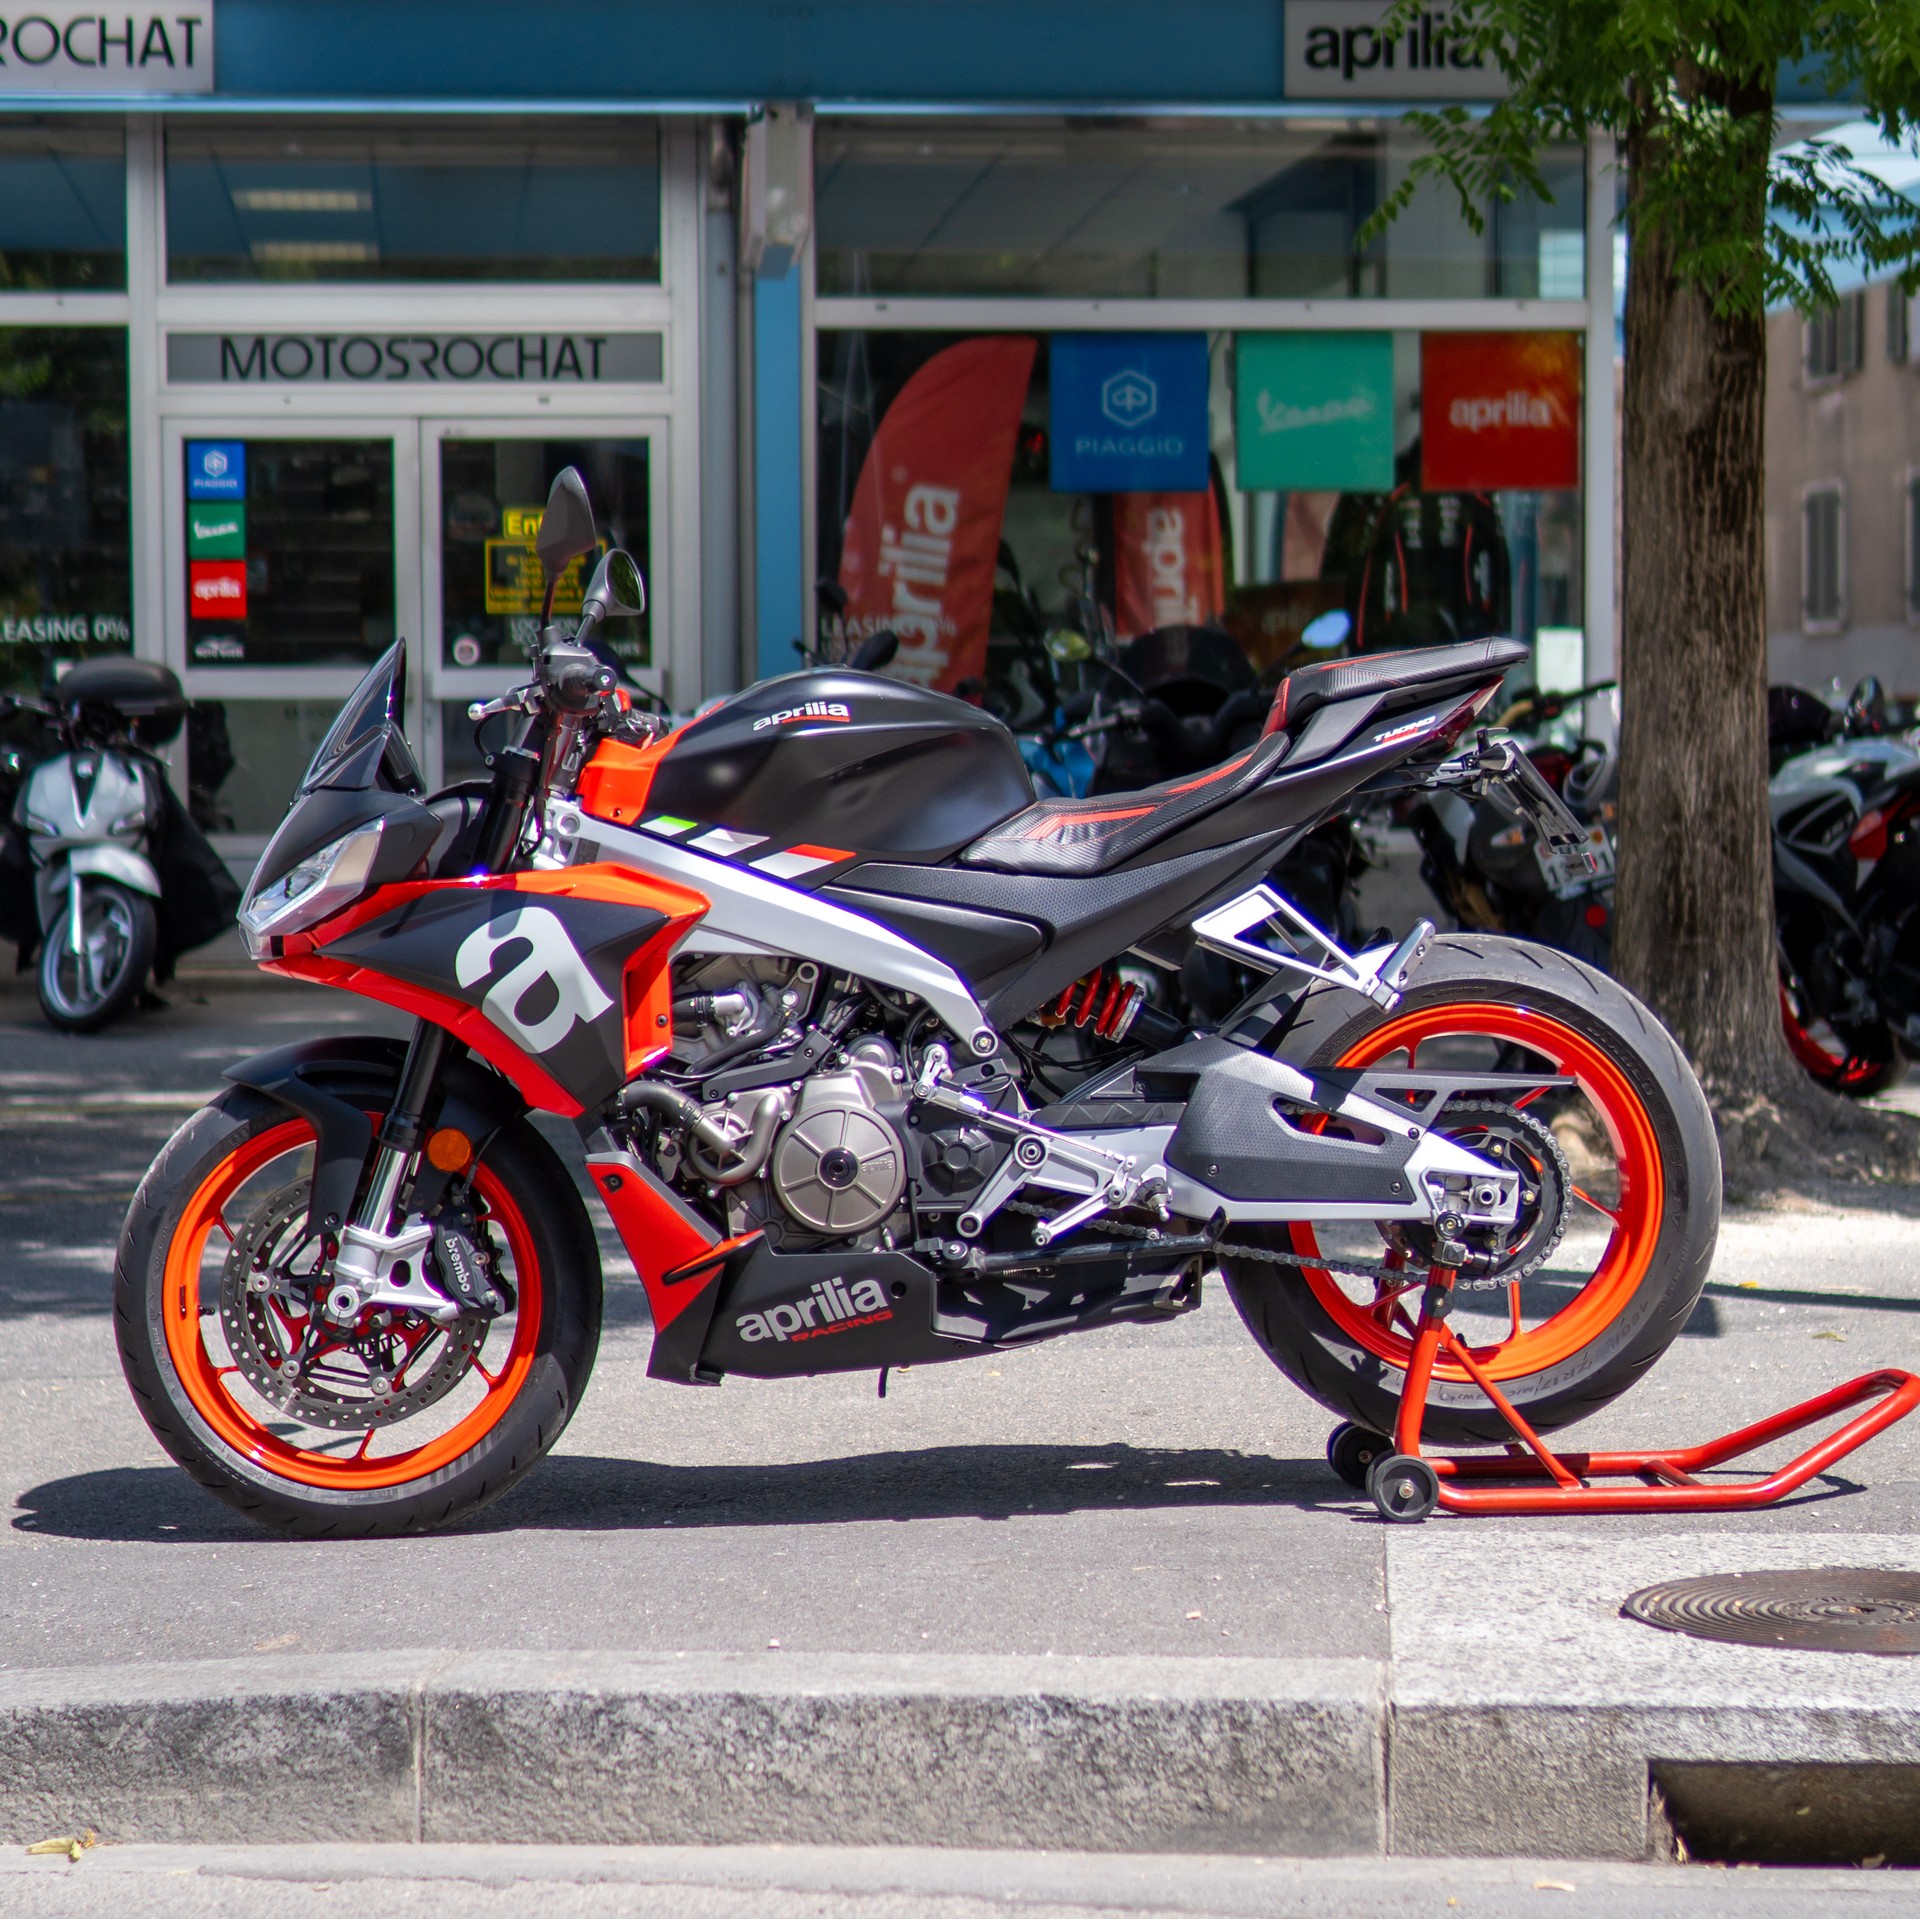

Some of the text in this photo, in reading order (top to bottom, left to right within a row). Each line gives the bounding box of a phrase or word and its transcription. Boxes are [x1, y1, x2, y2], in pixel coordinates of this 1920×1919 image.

[1449, 389, 1552, 433] aprilia
[1075, 438, 1183, 457] PIAGGIO
[193, 577, 241, 601] aprilia
[0, 615, 131, 642] EASING 0%
[752, 701, 850, 732] aprilia
[1372, 715, 1437, 743] TUONO
[454, 906, 616, 1054] a
[860, 1157, 894, 1176] aprilia
[445, 1236, 471, 1293] brembo
[735, 1276, 889, 1343] aprilia
[790, 1309, 895, 1343] RACING
